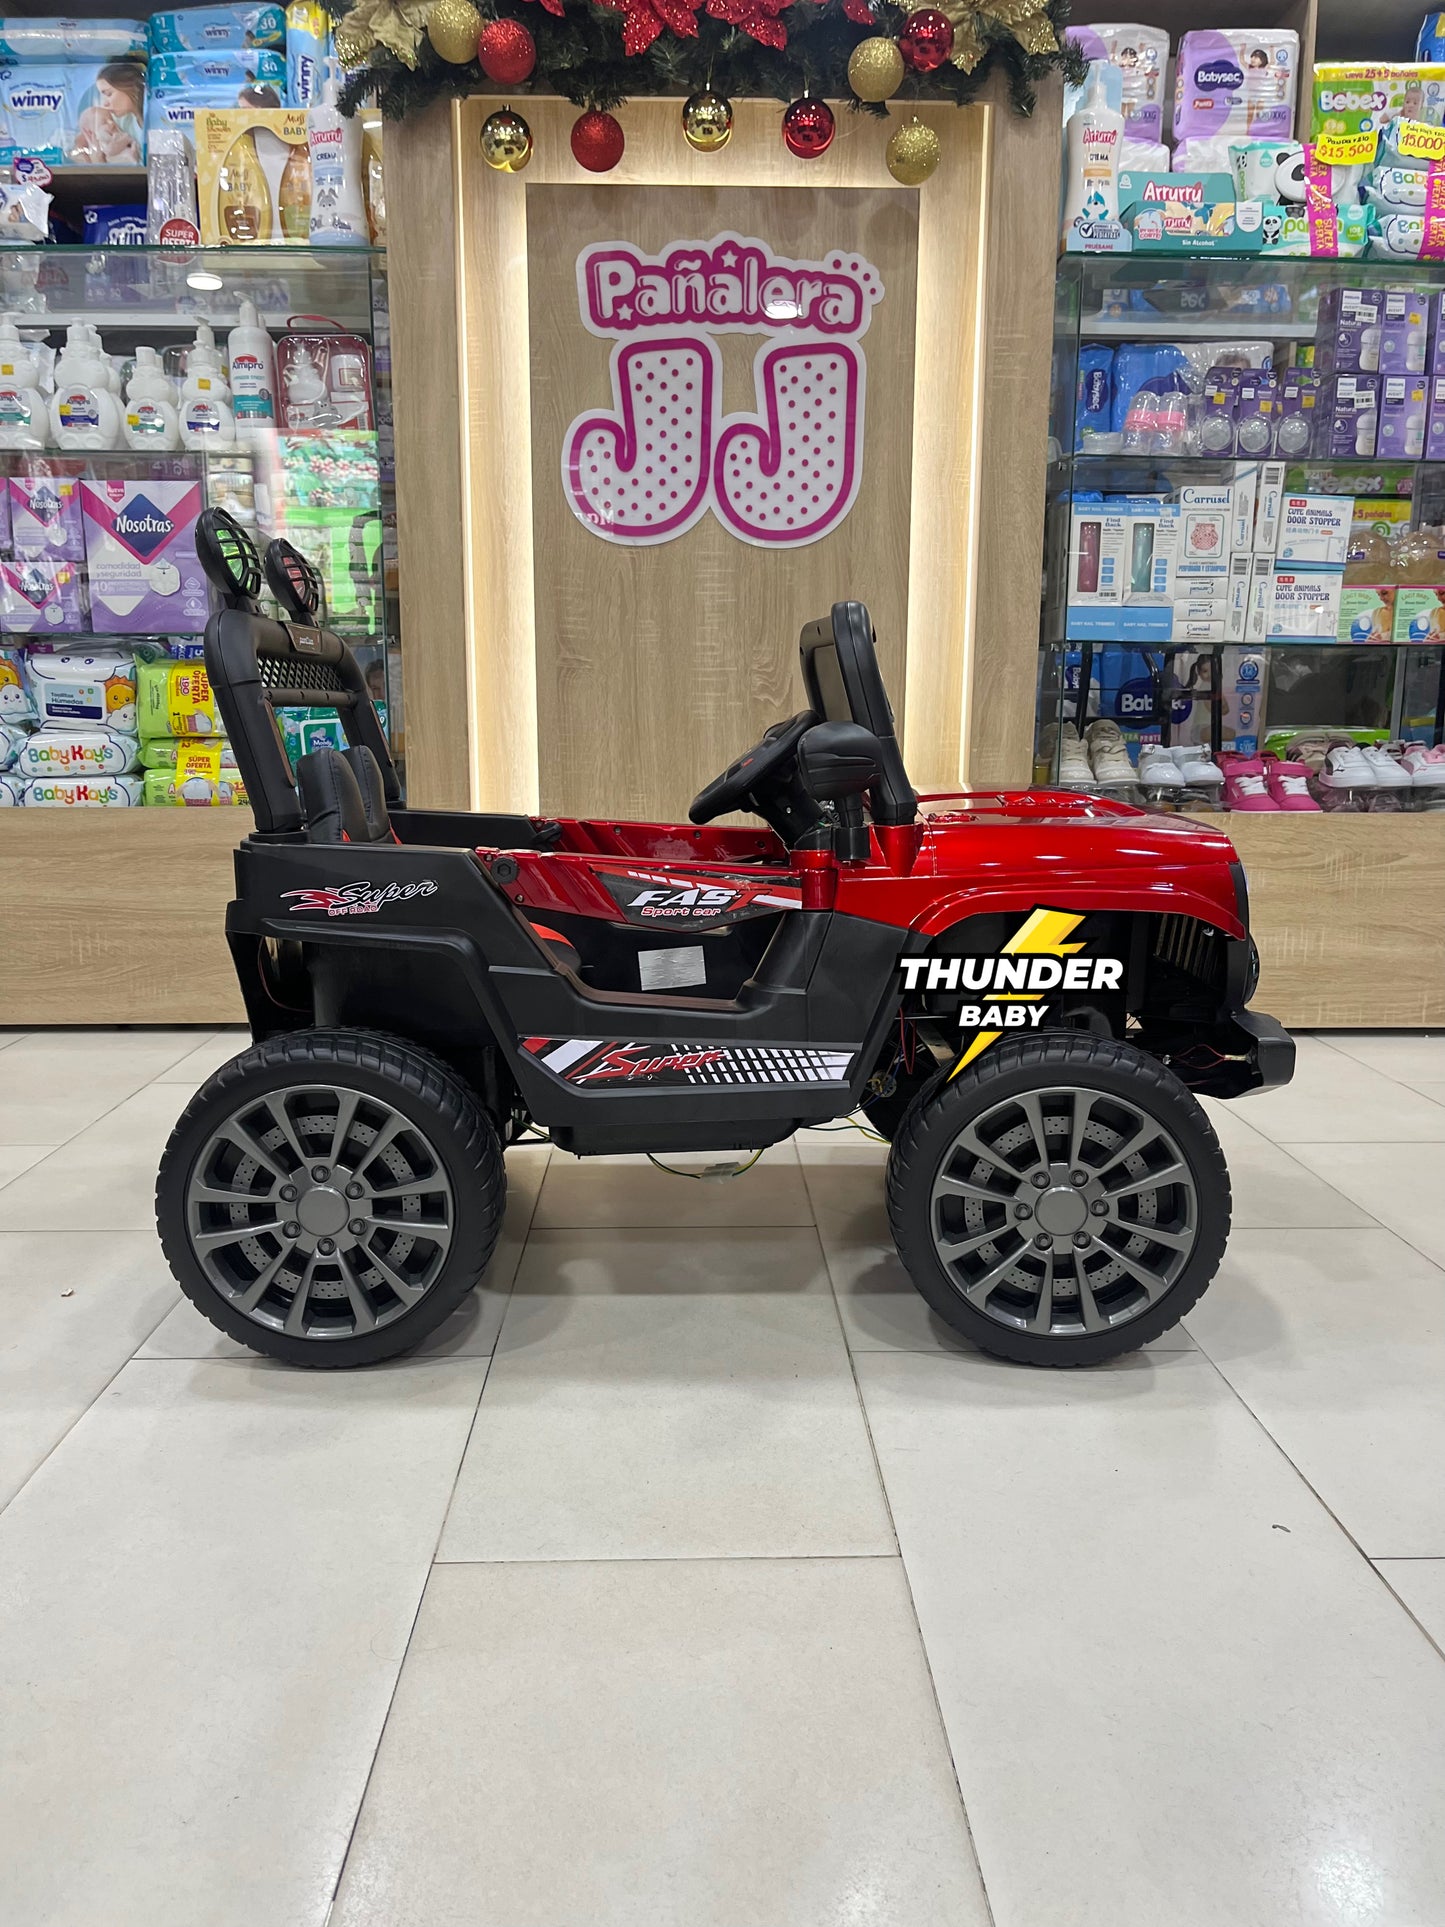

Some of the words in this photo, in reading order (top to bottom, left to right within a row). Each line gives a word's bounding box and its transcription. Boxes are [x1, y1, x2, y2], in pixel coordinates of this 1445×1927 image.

[205, 27, 229, 38] winny
[204, 65, 230, 76] winny
[297, 55, 314, 100] winny
[1197, 71, 1241, 84] Babysec
[11, 89, 62, 112] winny
[1318, 90, 1387, 112] Bebex
[283, 127, 307, 136] BABY
[165, 228, 194, 239] SUPER
[592, 252, 858, 328] Pañalera
[232, 360, 264, 371] Almipro
[569, 338, 858, 541] JJ
[1182, 488, 1231, 504] Carrusel
[29, 498, 63, 510] Nosotras
[1287, 508, 1305, 517] CUTE
[1306, 508, 1333, 517] ANIMALS
[116, 513, 172, 534] Nosotras
[1287, 515, 1307, 526] DOOR
[1309, 516, 1341, 527] STOPPER
[1275, 584, 1292, 592] CUTE
[1293, 584, 1321, 592] ANIMALS
[1275, 592, 1295, 601] DOOR
[1298, 592, 1330, 601] STOPPER
[192, 670, 202, 705] OFERTA
[28, 746, 70, 765] Baby
[71, 745, 113, 763] Kay's
[33, 785, 75, 805] Baby
[76, 785, 118, 804] Kay's
[329, 880, 439, 910] Super
[626, 888, 773, 912] FAST
[328, 907, 348, 917] OFF
[641, 906, 691, 918] Sport
[692, 907, 722, 917] car
